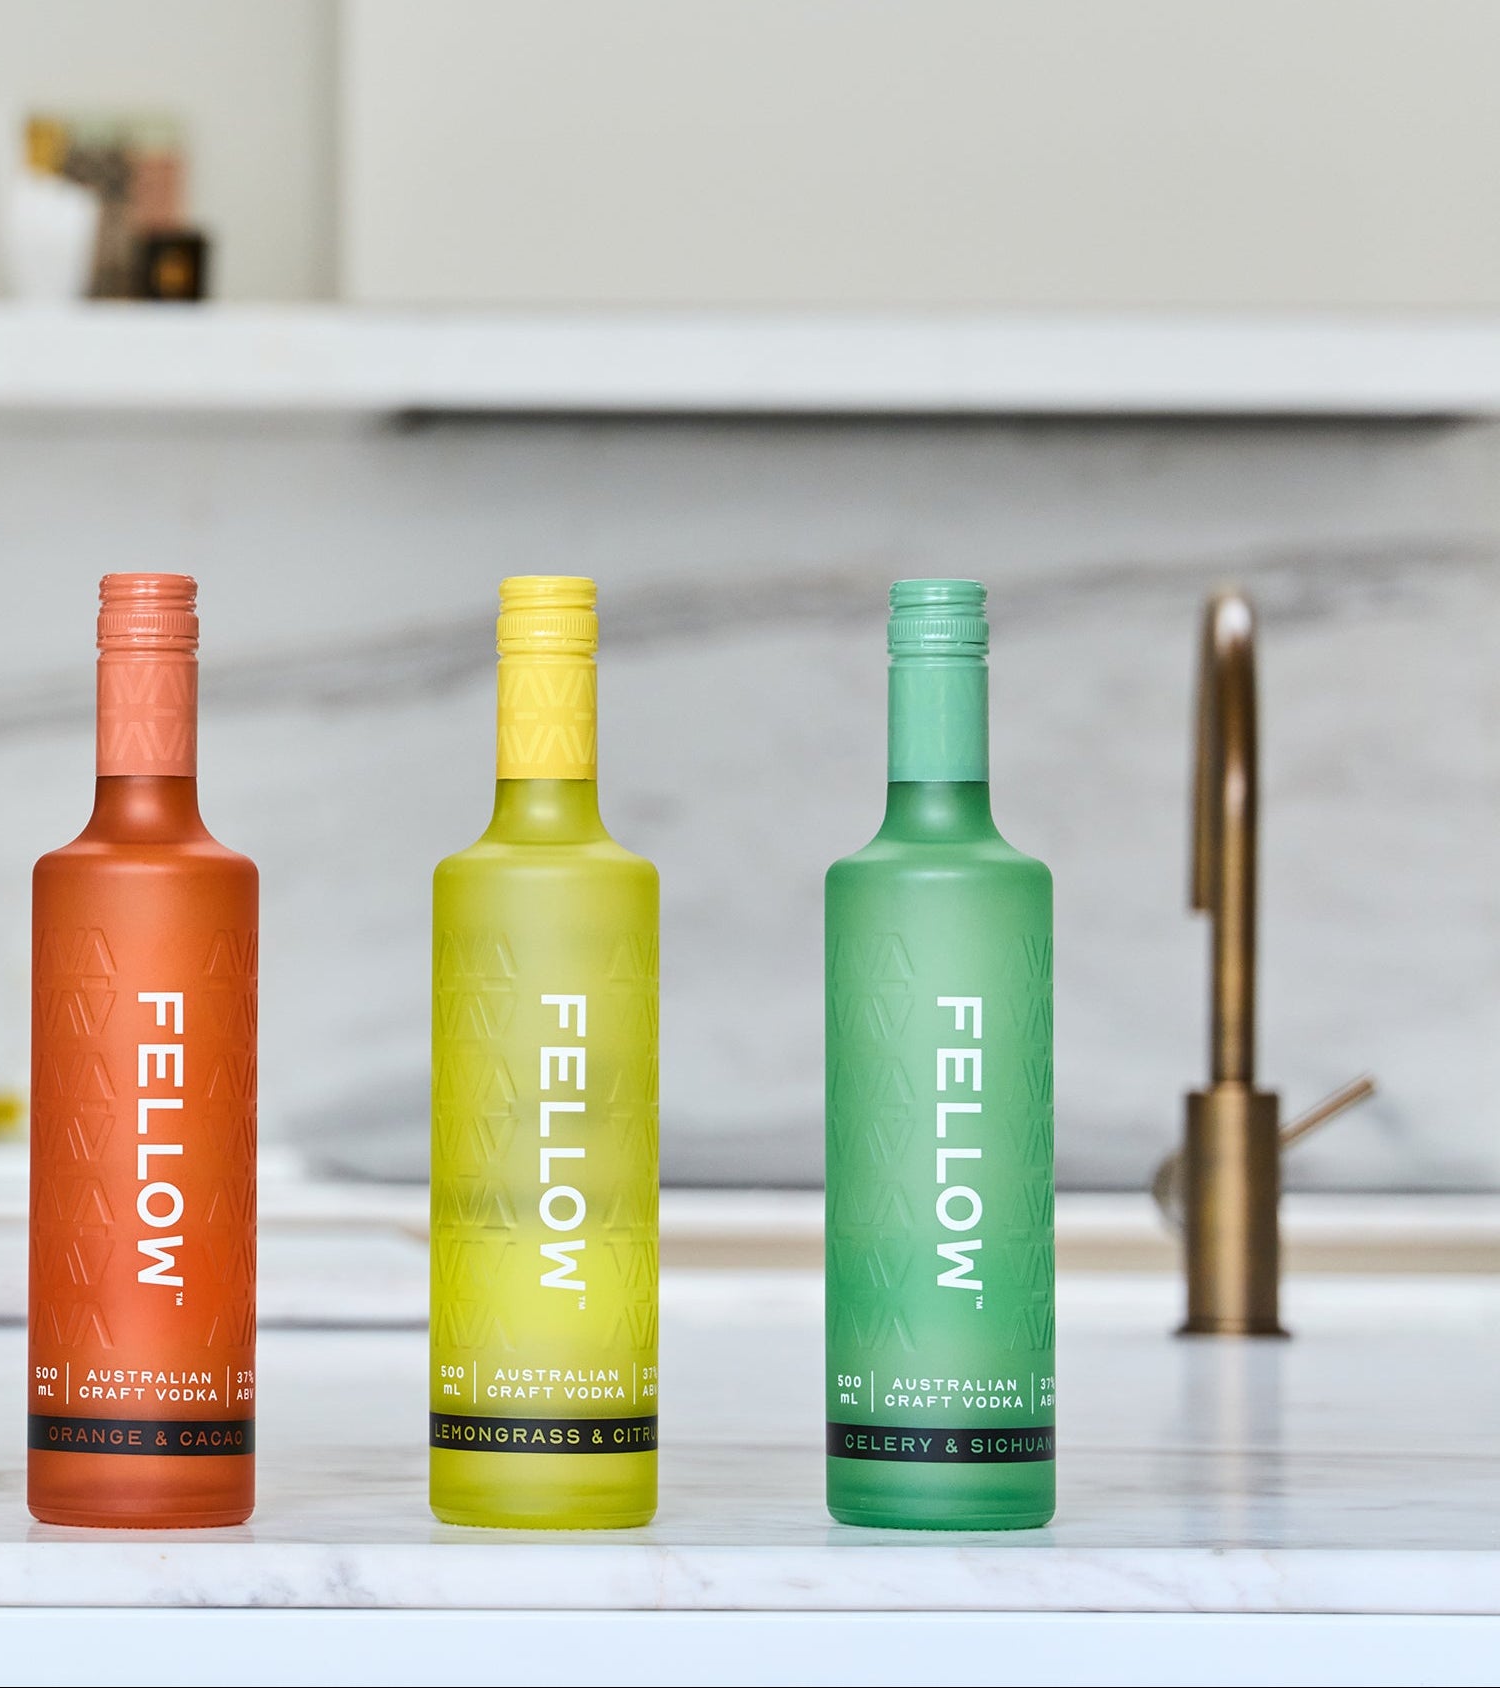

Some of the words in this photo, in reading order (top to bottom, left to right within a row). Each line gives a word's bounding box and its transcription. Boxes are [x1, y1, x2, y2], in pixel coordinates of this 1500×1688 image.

[136, 991, 185, 1288] FELLOW
[539, 994, 587, 1291] FELLOW
[935, 996, 983, 1291] FELLOW
[35, 1366, 58, 1380] 500
[86, 1370, 212, 1384] AUSTRALIAN
[440, 1365, 465, 1379] 500
[494, 1368, 619, 1382] AUSTRALIAN
[837, 1374, 862, 1389] 500
[892, 1377, 1017, 1392] AUSTRALIAN
[38, 1383, 55, 1397] mL
[79, 1386, 145, 1400] CRAFT
[155, 1388, 218, 1402] VODKA
[443, 1383, 461, 1396] mL
[486, 1386, 554, 1399] CRAFT
[564, 1386, 626, 1400] VODKA
[840, 1392, 858, 1405] mL
[884, 1394, 952, 1408] CRAFT
[962, 1395, 1023, 1408] VODKA
[49, 1426, 143, 1445] ORANGE
[155, 1430, 168, 1446] &
[179, 1430, 243, 1447] CACAO
[435, 1422, 581, 1445] LEMONGRASS
[591, 1428, 603, 1444] &
[613, 1426, 658, 1444] CITRU
[845, 1433, 933, 1452] CELERY
[945, 1437, 958, 1454] &
[970, 1436, 1052, 1454] SICHUAN
